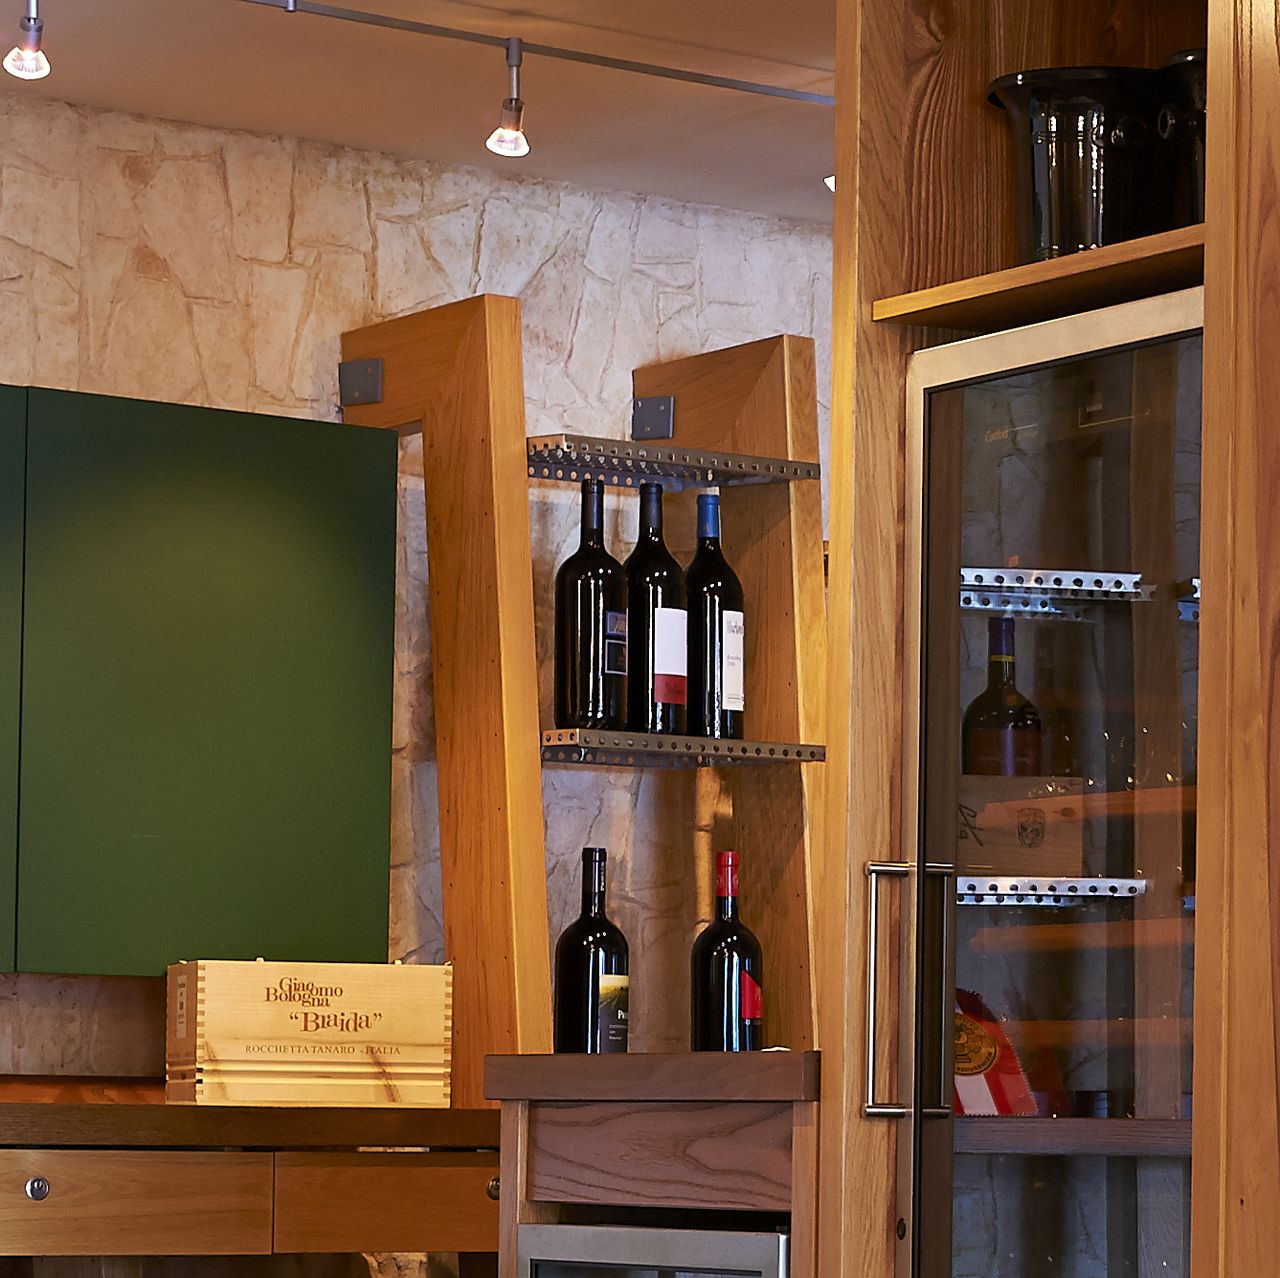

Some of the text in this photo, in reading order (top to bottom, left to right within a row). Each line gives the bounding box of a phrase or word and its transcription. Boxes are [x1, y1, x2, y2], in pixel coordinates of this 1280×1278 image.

[265, 987, 331, 1008] Bologna
[279, 976, 344, 998] Giacomo
[245, 1044, 310, 1055] ROCCHETTA
[310, 1045, 356, 1055] TANARO
